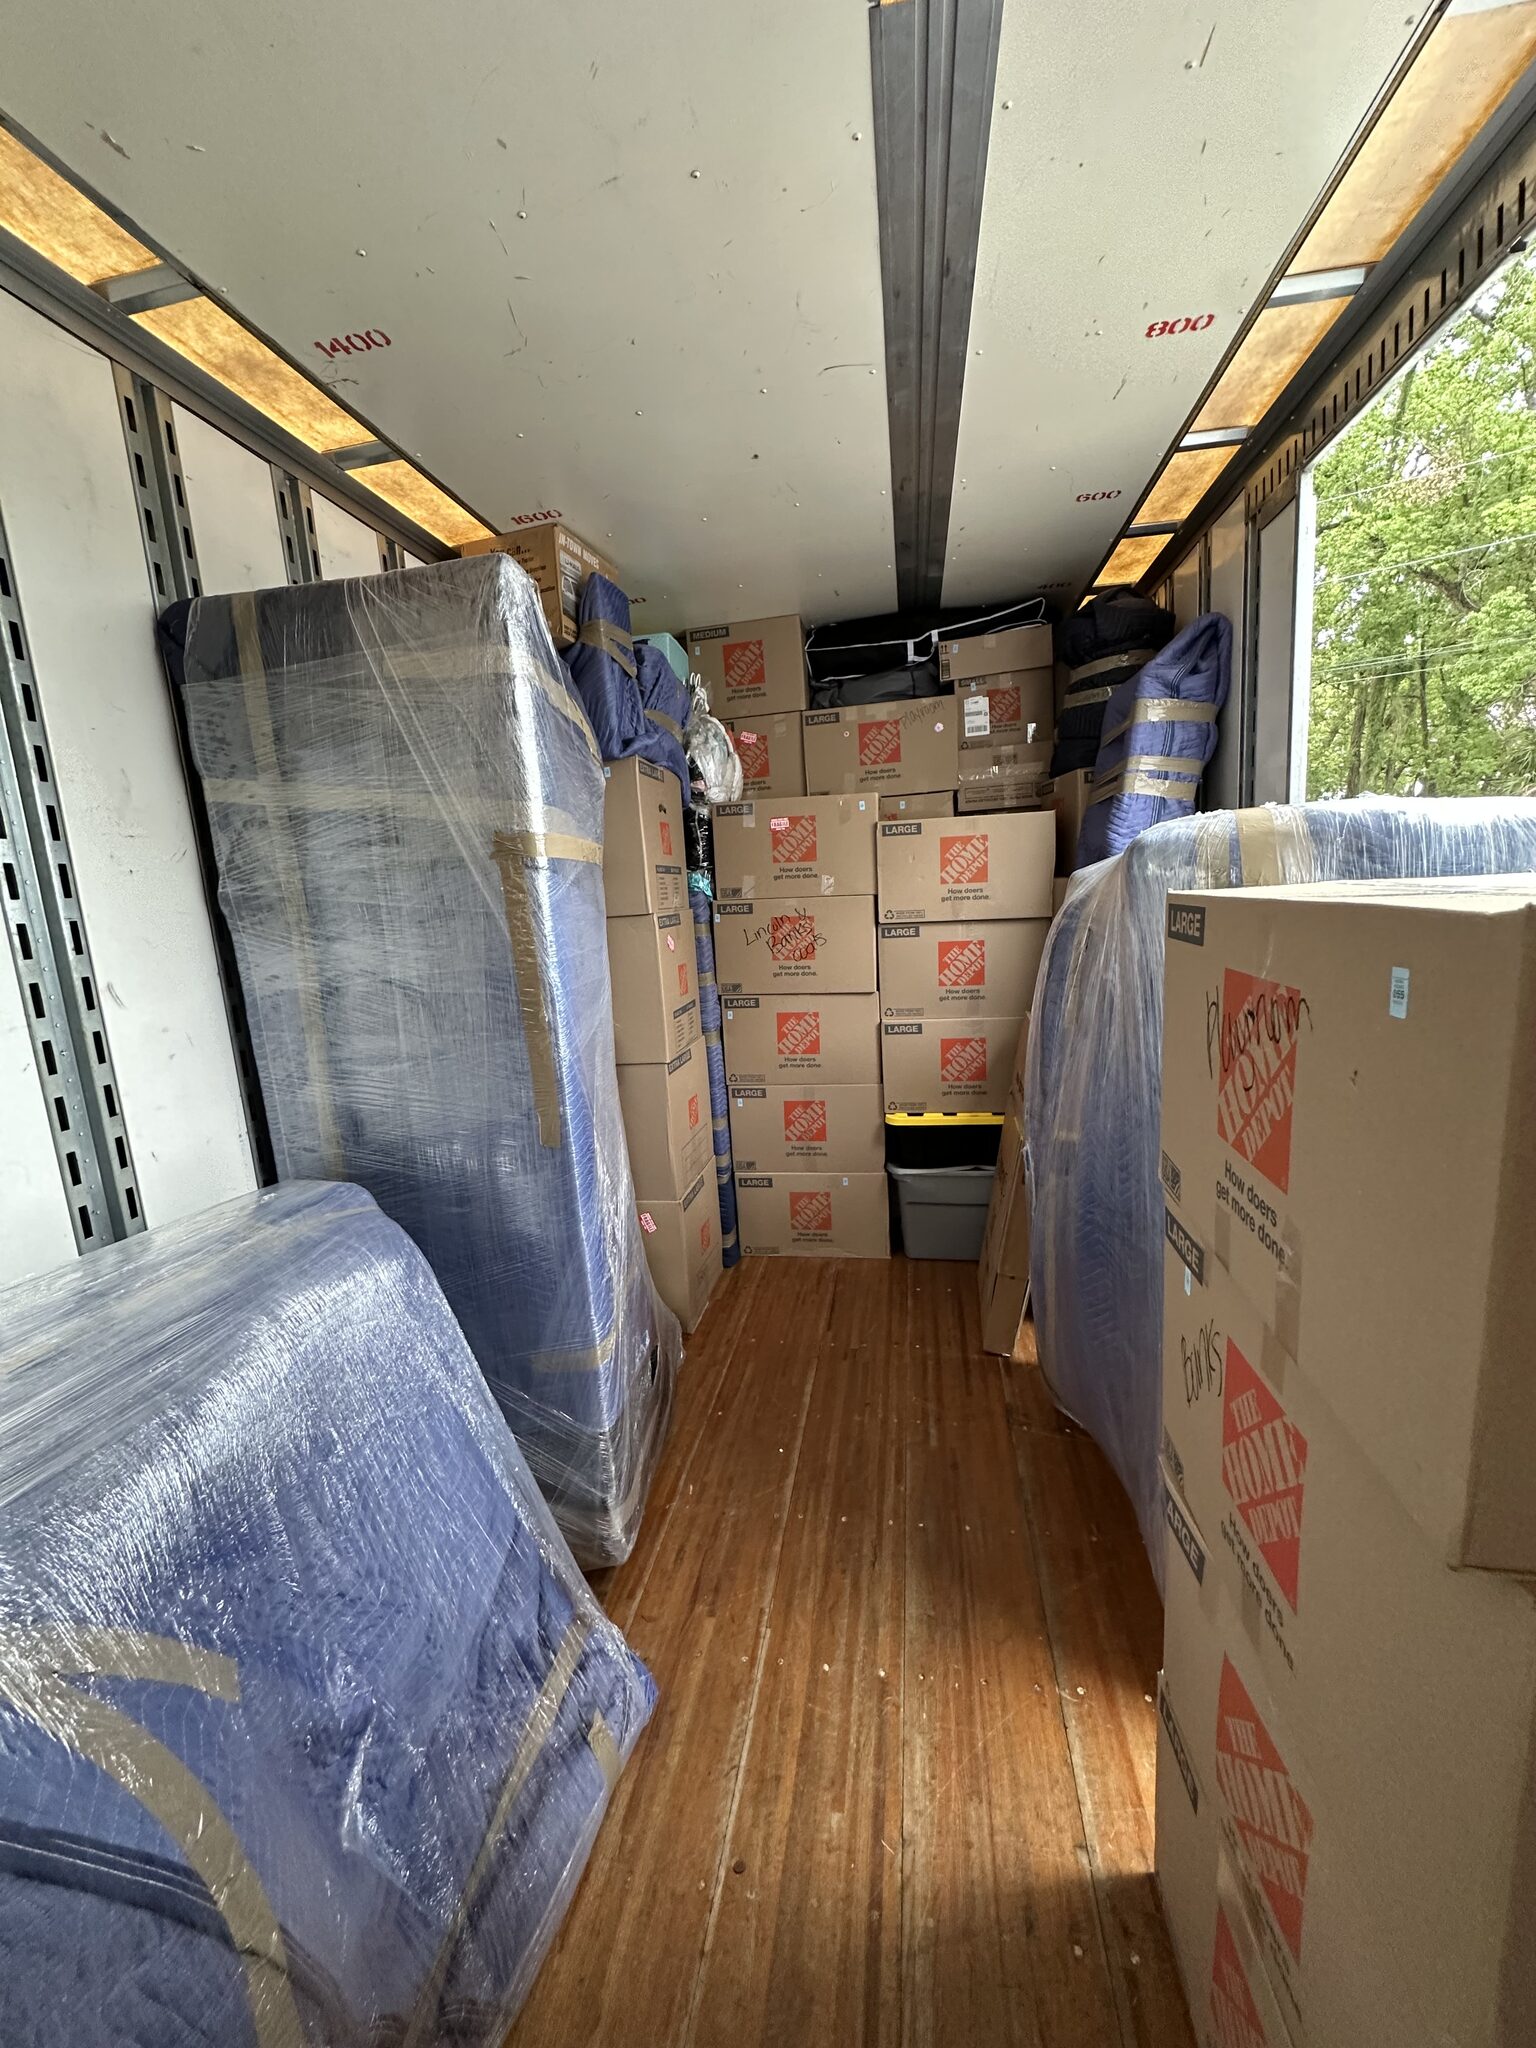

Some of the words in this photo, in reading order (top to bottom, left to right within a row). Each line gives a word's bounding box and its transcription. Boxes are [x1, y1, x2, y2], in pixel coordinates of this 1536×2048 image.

[1145, 314, 1215, 337] 800
[314, 329, 391, 358] 1400
[1076, 490, 1121, 502] 600
[511, 510, 562, 525] 1600
[693, 628, 726, 639] MEDIUM
[808, 714, 837, 725] LARGE
[860, 721, 900, 766] HOME
[863, 726, 880, 744] THE
[876, 735, 901, 764] DEPOT
[720, 805, 750, 815] LARGE
[886, 825, 918, 835] LARGE
[940, 835, 988, 884] HOME
[944, 841, 966, 860] THE
[958, 852, 988, 884] DEPOT
[721, 905, 749, 913] LARGE
[1170, 910, 1201, 937] LARGE
[744, 915, 790, 946] Lincoln
[884, 928, 916, 937] LARGE
[939, 940, 985, 986] HOME
[942, 945, 962, 965] THE
[957, 957, 985, 986] DEPOT
[777, 1012, 820, 1054] HOME
[781, 1016, 799, 1034] THE
[888, 1025, 919, 1033] LARGE
[794, 1027, 820, 1054] DEPOT
[945, 1043, 965, 1060] THE
[941, 1038, 986, 1081] HOME
[959, 1055, 986, 1081] DEPOT
[785, 1101, 826, 1141] HOME
[788, 1105, 804, 1121] THE
[1242, 1064, 1294, 1162] DEPOT
[801, 1117, 826, 1141] DEPOT
[1216, 1181, 1230, 1205] get
[1231, 1197, 1256, 1232] more
[1224, 1159, 1245, 1195] How
[1247, 1184, 1278, 1228] doers
[1167, 1215, 1200, 1274] LARGE
[1229, 1388, 1262, 1433] THE
[1223, 1418, 1308, 1505] HOME
[1167, 1499, 1200, 1570] ARGE
[1248, 1496, 1300, 1545] DEPOT
[1220, 1519, 1236, 1554] get
[1236, 1553, 1262, 1609] more
[1228, 1511, 1251, 1561] How
[1252, 1561, 1284, 1628] doers
